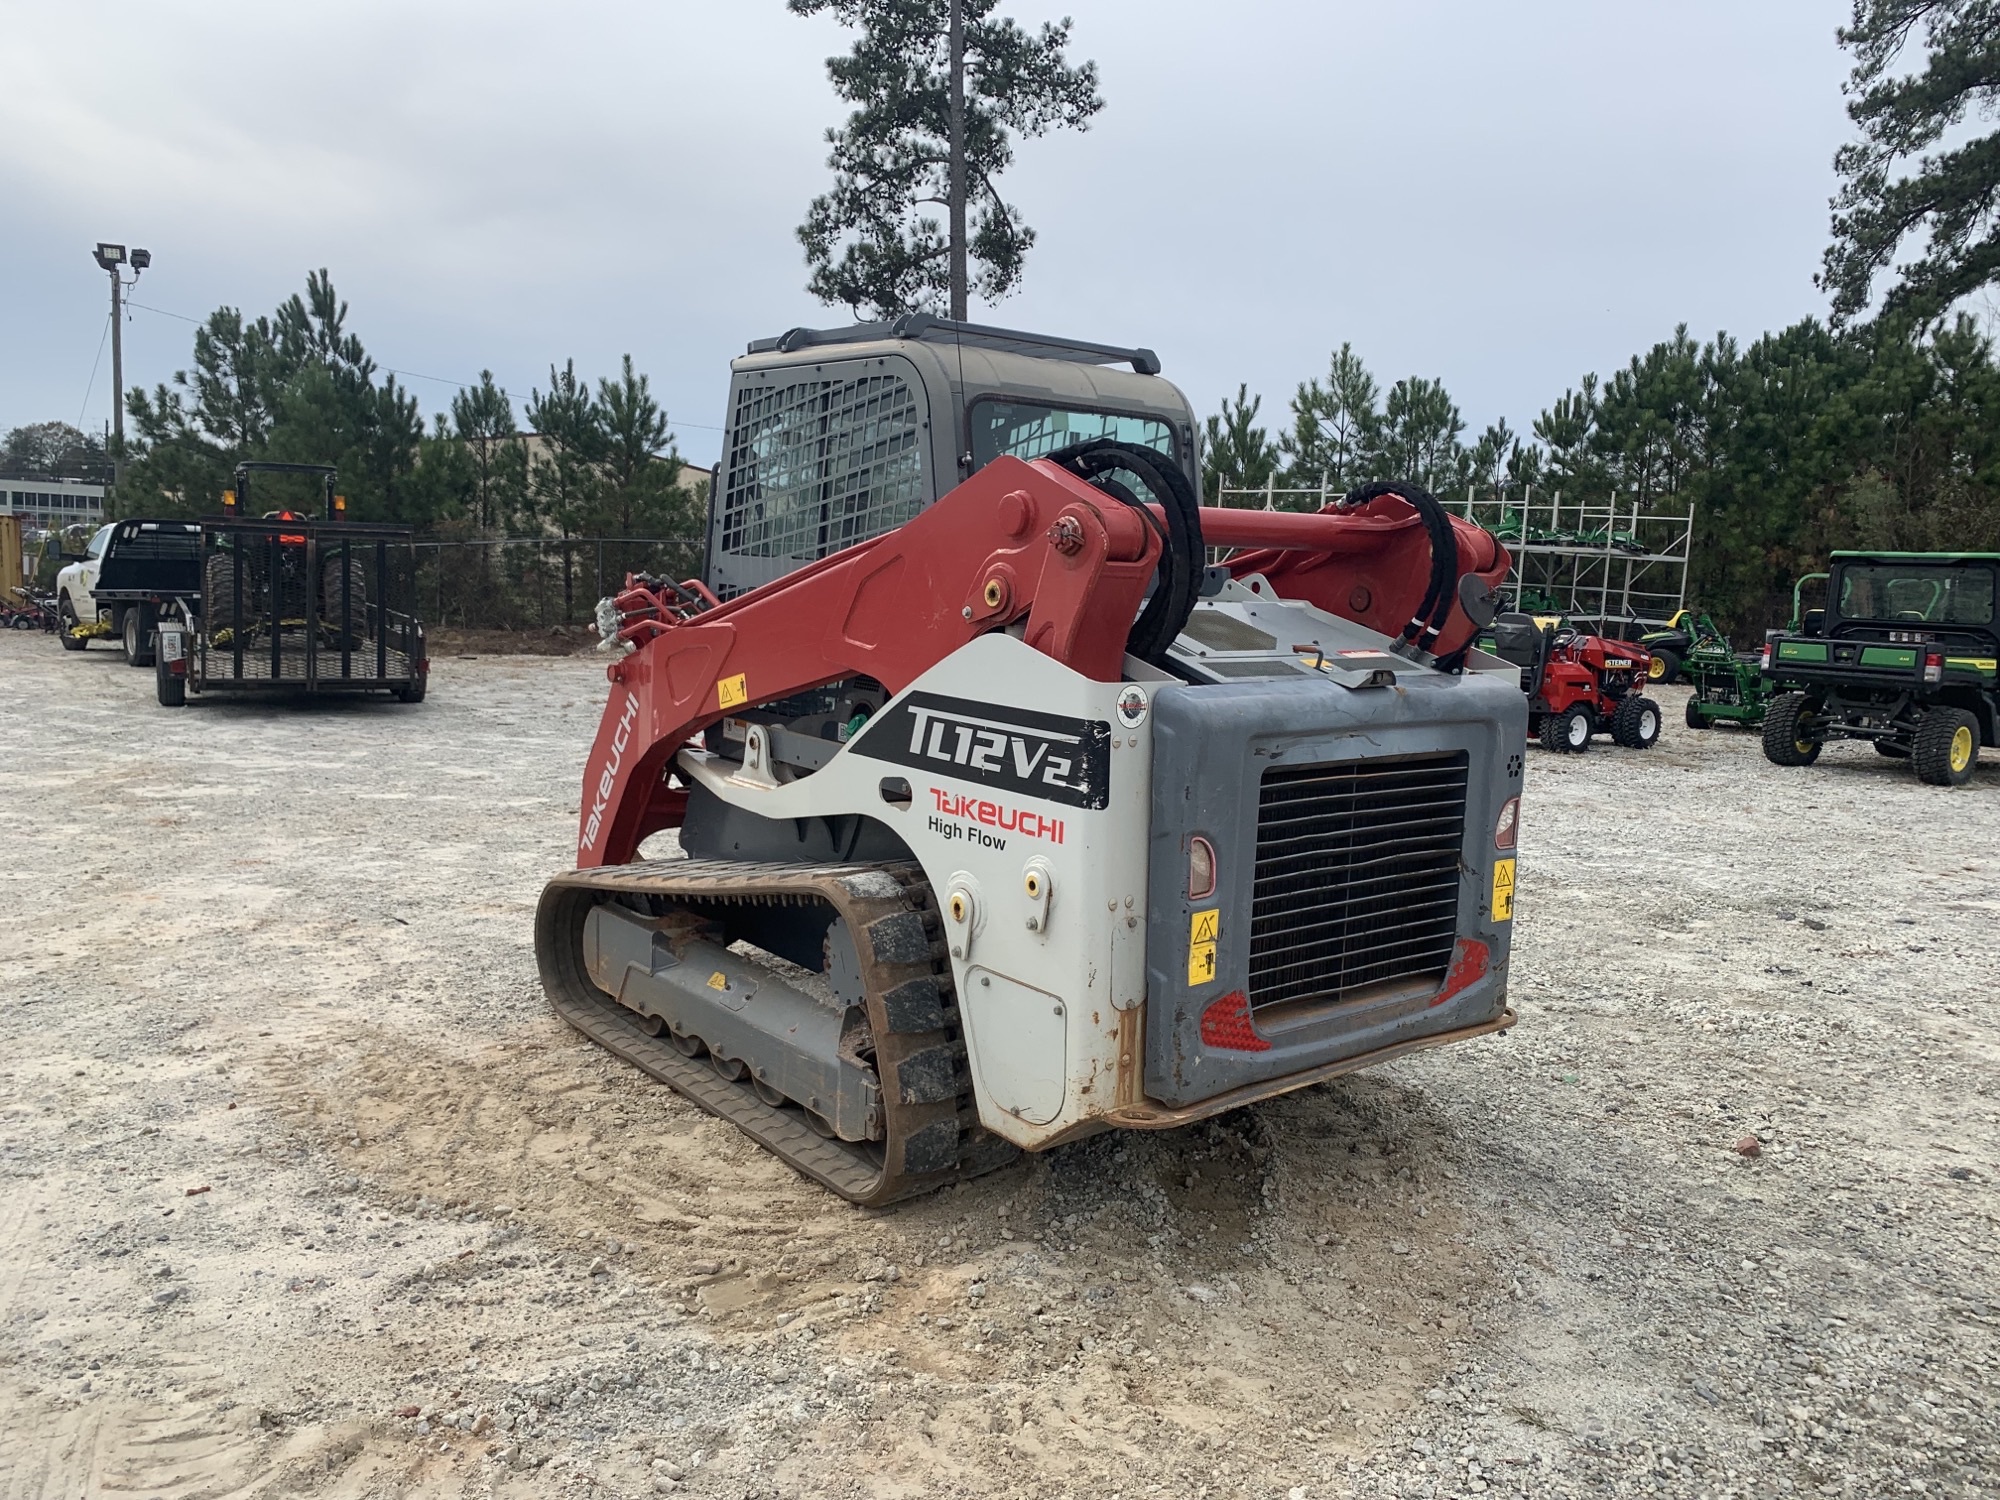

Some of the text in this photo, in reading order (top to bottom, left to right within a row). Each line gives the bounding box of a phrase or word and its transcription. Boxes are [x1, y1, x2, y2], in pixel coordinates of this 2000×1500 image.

[1606, 659, 1632, 667] STEINER
[928, 815, 1007, 851] High Flow
